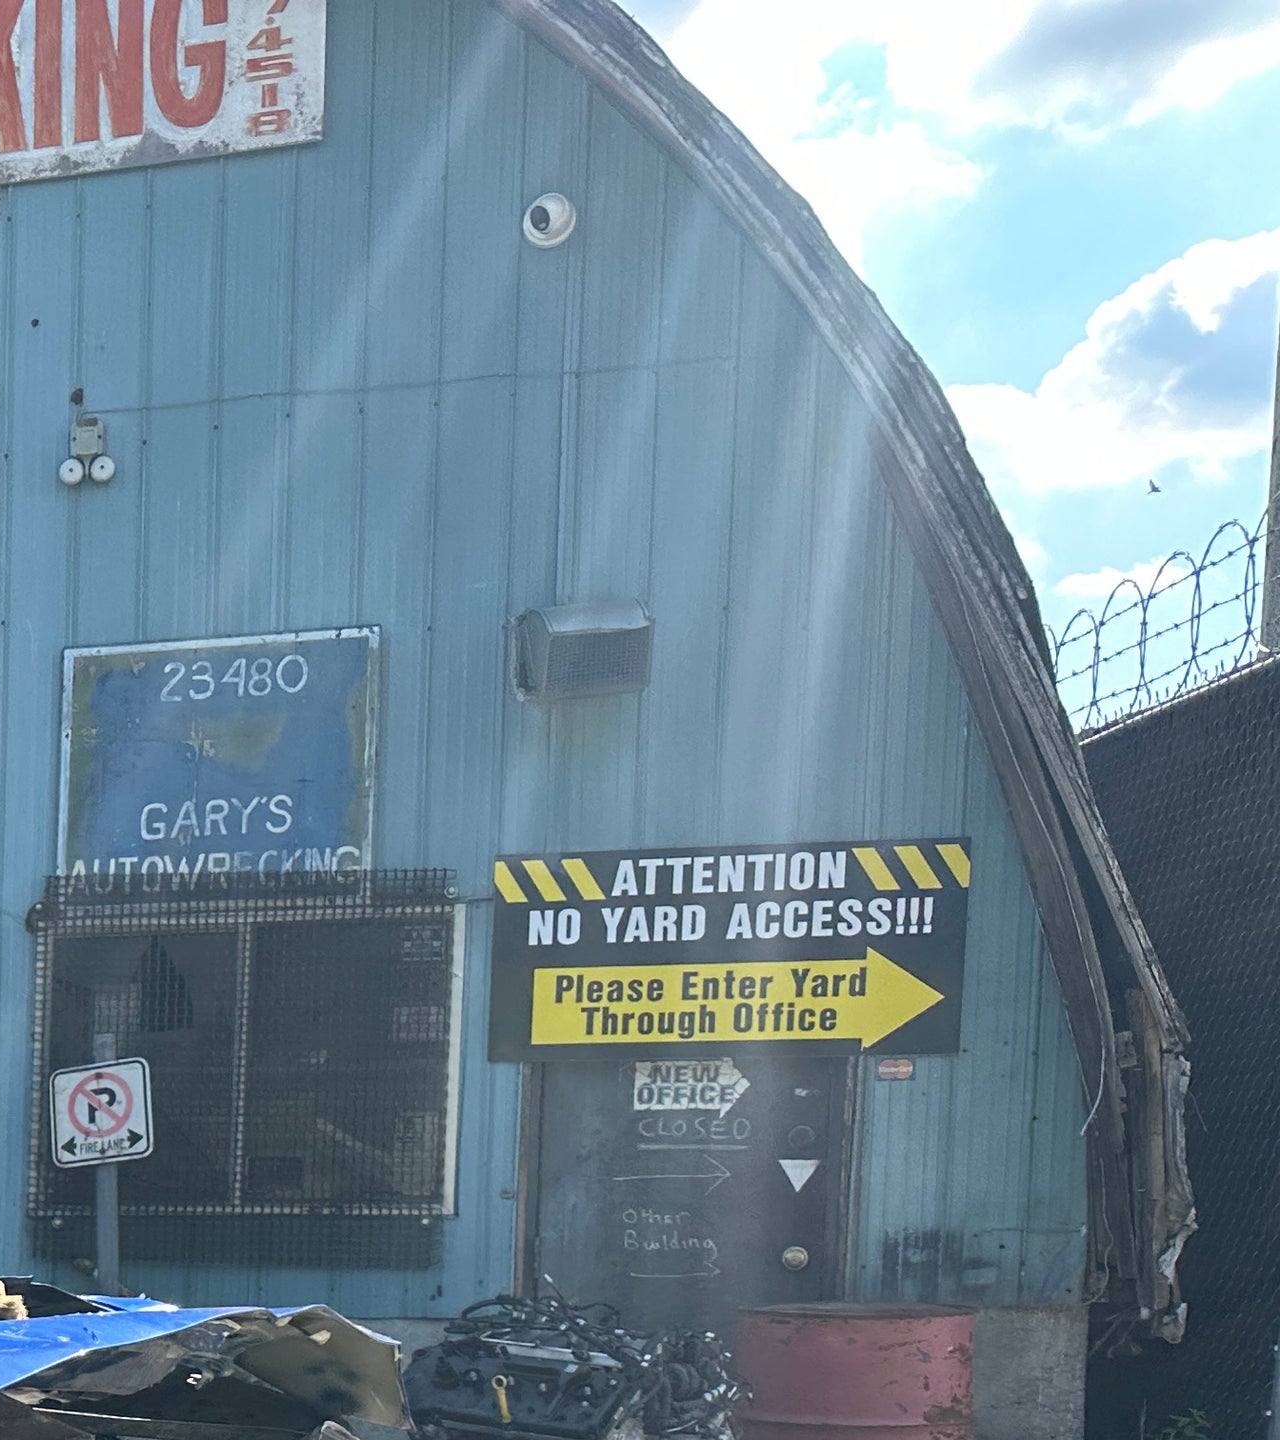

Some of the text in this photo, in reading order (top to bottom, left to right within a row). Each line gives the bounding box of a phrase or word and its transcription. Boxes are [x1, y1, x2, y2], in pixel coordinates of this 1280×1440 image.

[160, 654, 309, 702] 23480
[140, 794, 293, 841] GARY'S
[611, 850, 847, 897] ATTENTION
[527, 896, 935, 946] NO YARD ACCESS!!!
[554, 966, 867, 1004] Please Enter Yard
[581, 1001, 838, 1041] Through Office
[648, 1064, 720, 1084] NEW
[637, 1083, 736, 1105] OFFICE
[639, 1117, 751, 1140] CLOSED
[80, 1141, 99, 1156] FIRE
[622, 1207, 690, 1225] Other
